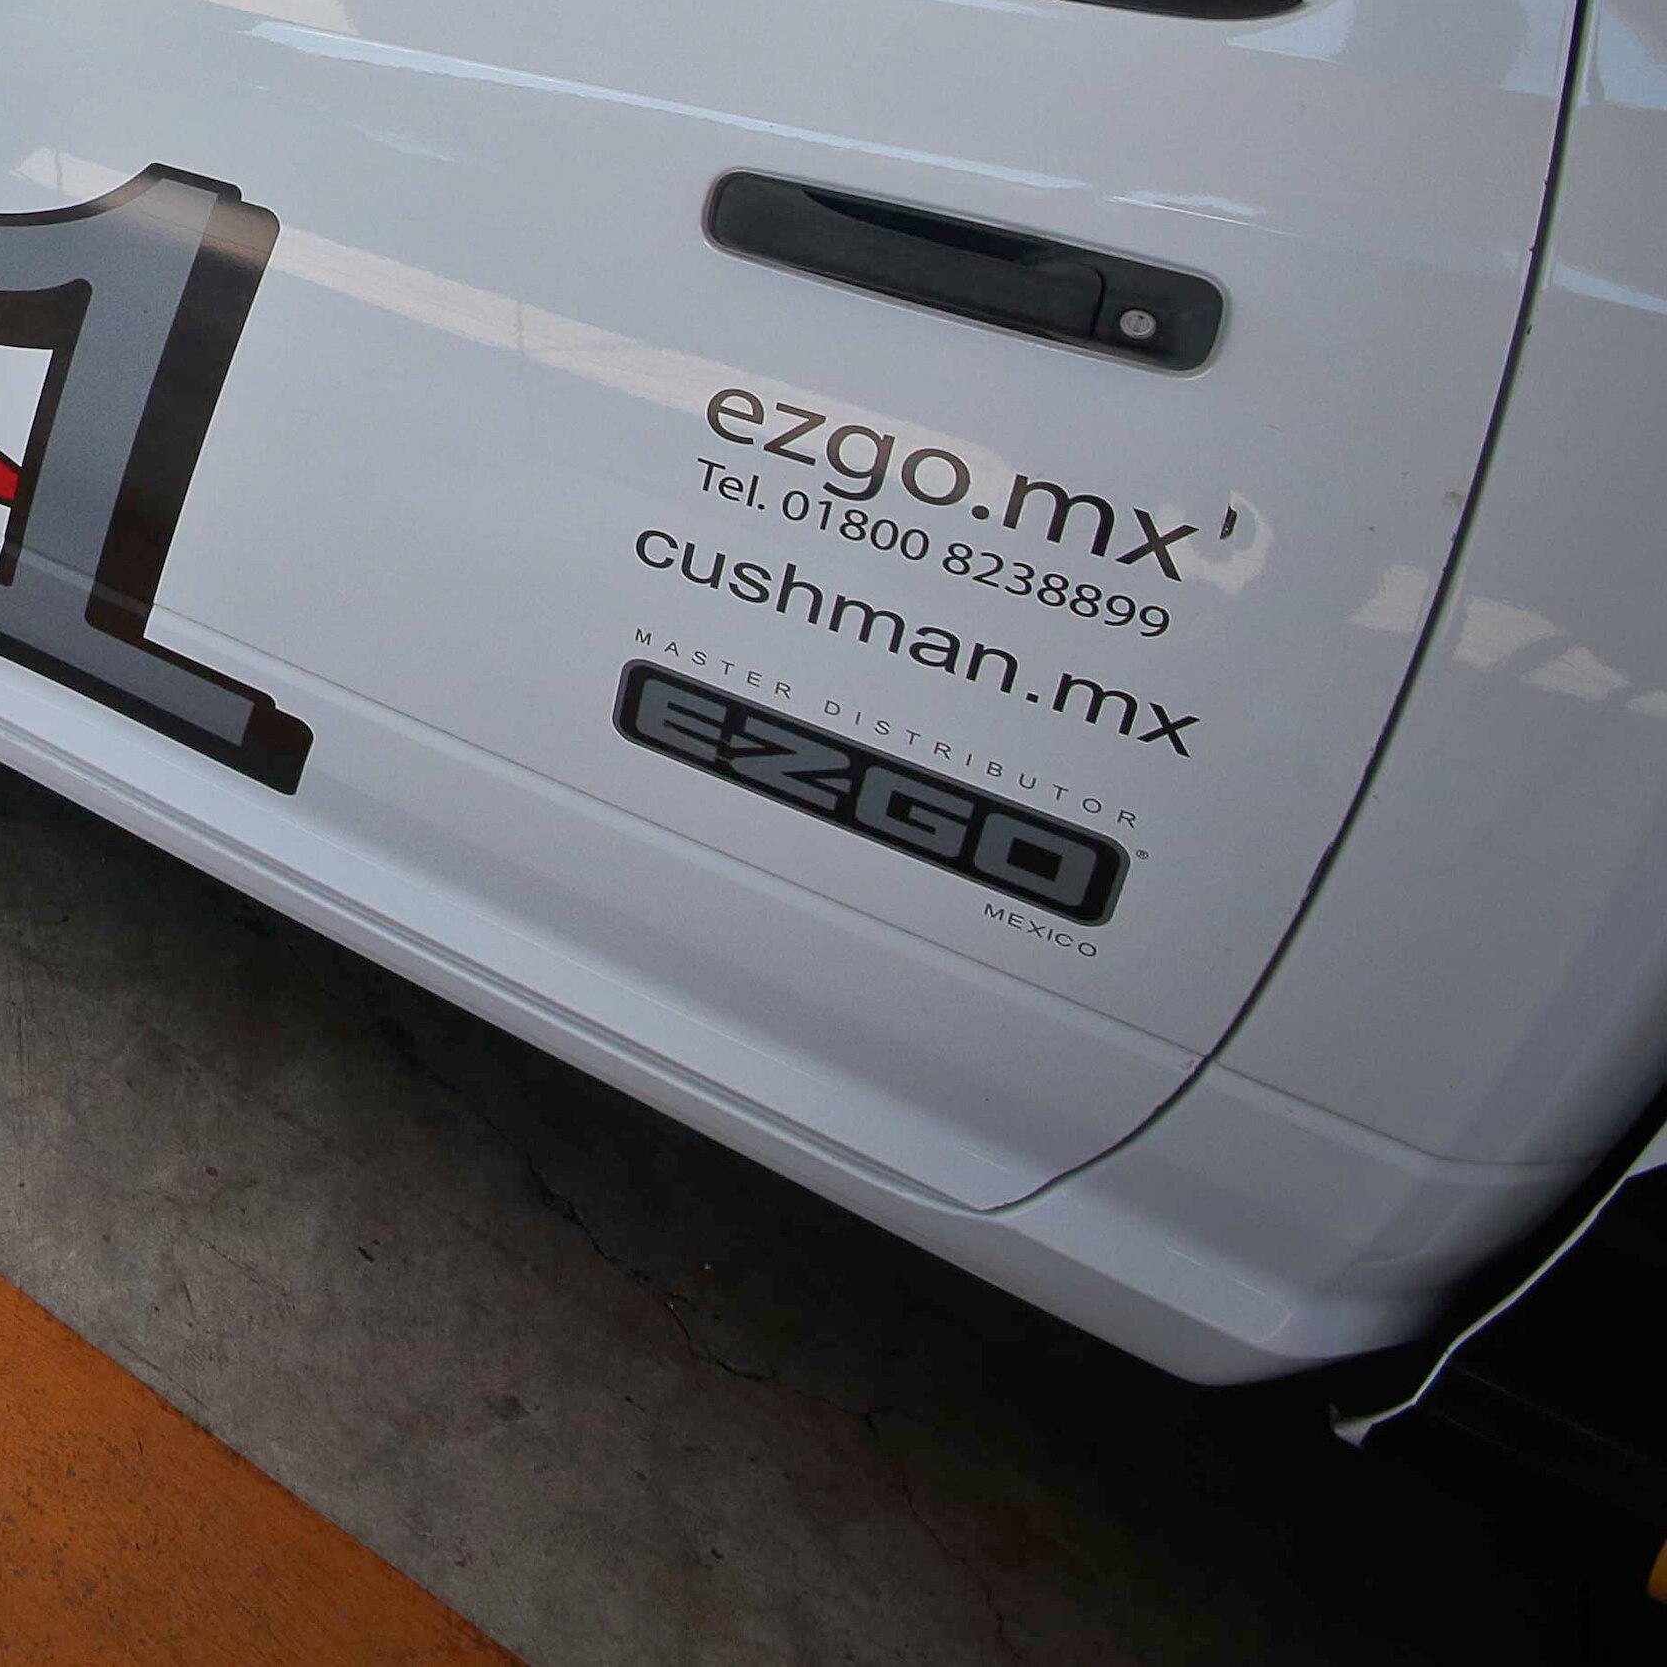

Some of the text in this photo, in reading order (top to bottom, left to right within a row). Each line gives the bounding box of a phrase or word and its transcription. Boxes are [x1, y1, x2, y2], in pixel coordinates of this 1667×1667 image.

[696, 457, 1171, 637] Tel. 01800 8238899
[705, 387, 1198, 583] ezgo.mx
[634, 529, 1201, 759] cushman.mx
[635, 629, 1137, 828] MASTER DISTRIBUTOR
[634, 677, 1099, 907] EZGO
[983, 903, 1098, 958] MEXICO
